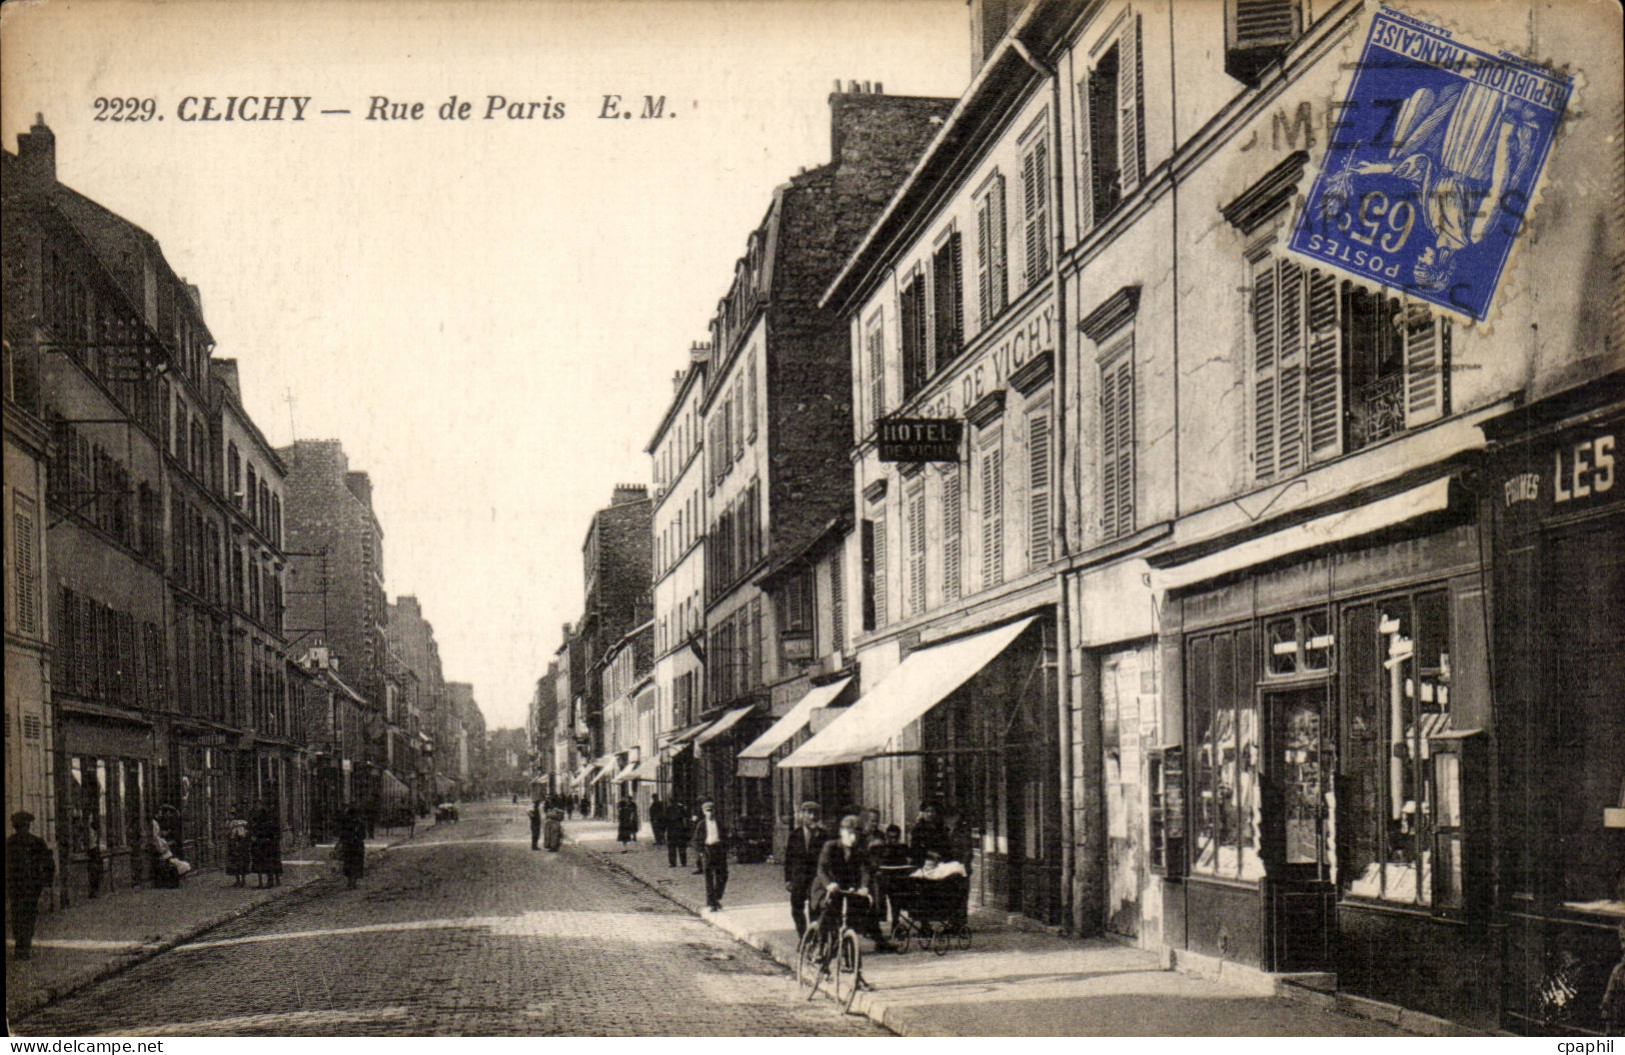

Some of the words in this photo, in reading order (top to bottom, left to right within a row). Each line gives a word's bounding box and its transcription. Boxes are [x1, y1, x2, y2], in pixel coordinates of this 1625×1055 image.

[1240, 96, 1407, 152] MEZ
[1307, 233, 1400, 278] POSTES
[962, 364, 985, 409] DE
[992, 303, 1055, 383] VICHY
[882, 423, 953, 442] HOTEL
[1554, 434, 1615, 502] LES
